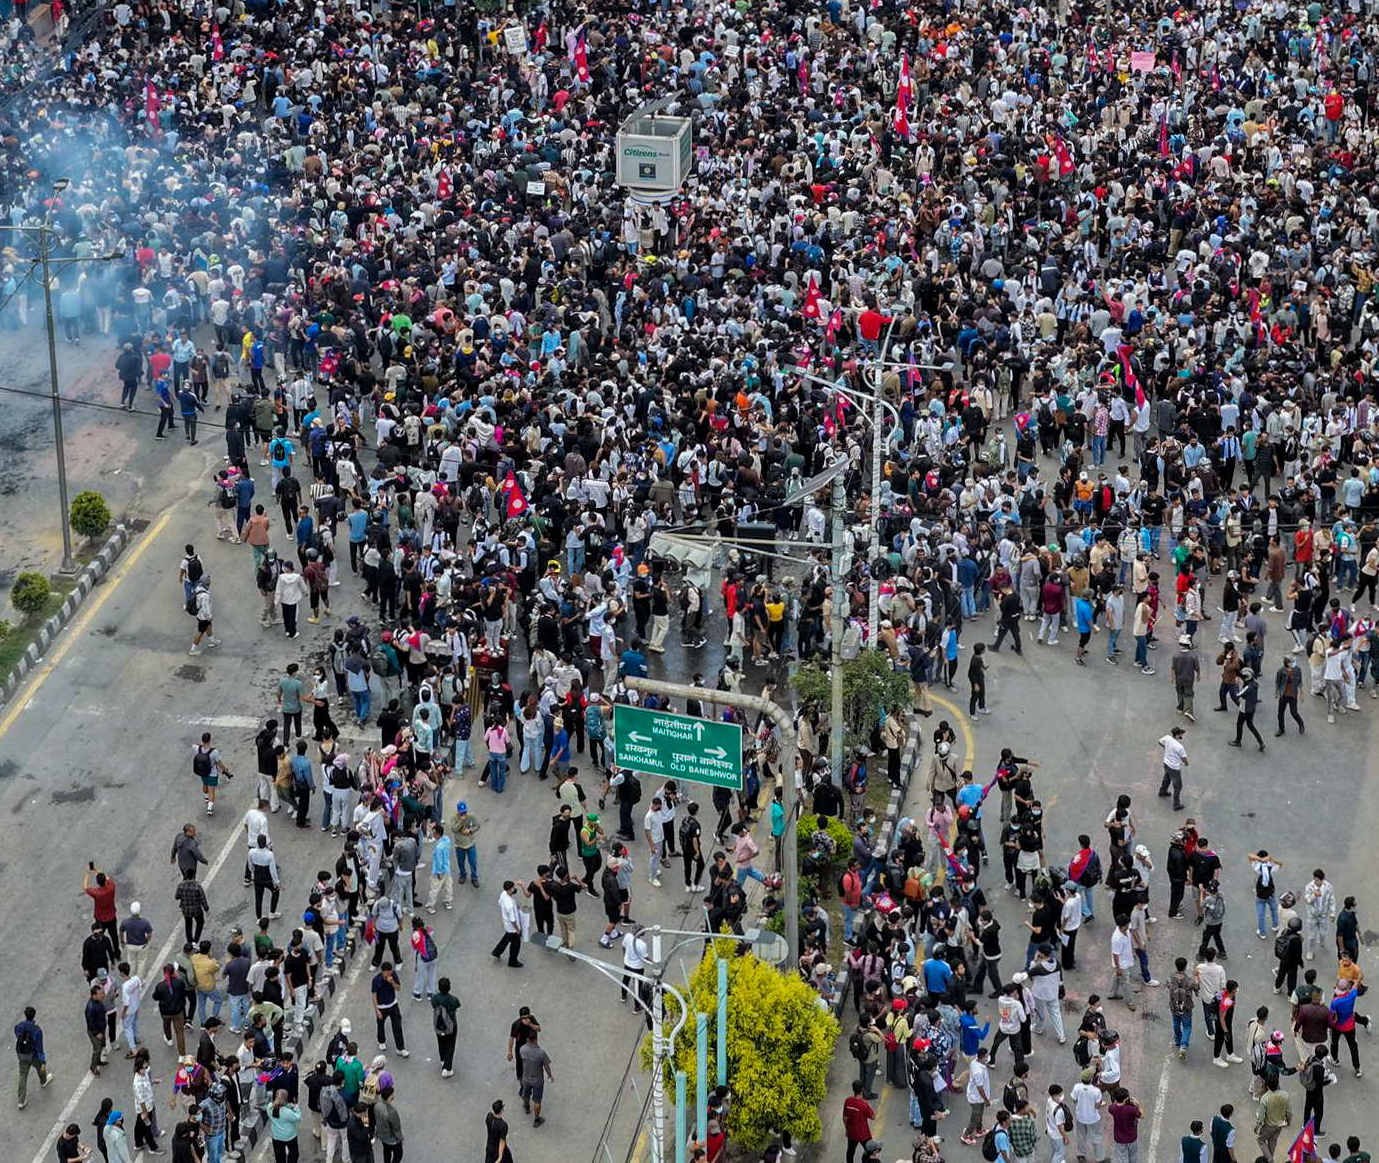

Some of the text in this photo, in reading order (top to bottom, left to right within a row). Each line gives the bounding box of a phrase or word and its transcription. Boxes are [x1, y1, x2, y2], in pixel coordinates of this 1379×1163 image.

[624, 148, 658, 158] Citizens
[652, 726, 693, 741] MAITIGHAR
[618, 753, 665, 768] SANKHAMUL
[671, 763, 738, 781] OLD BANESHWOR
